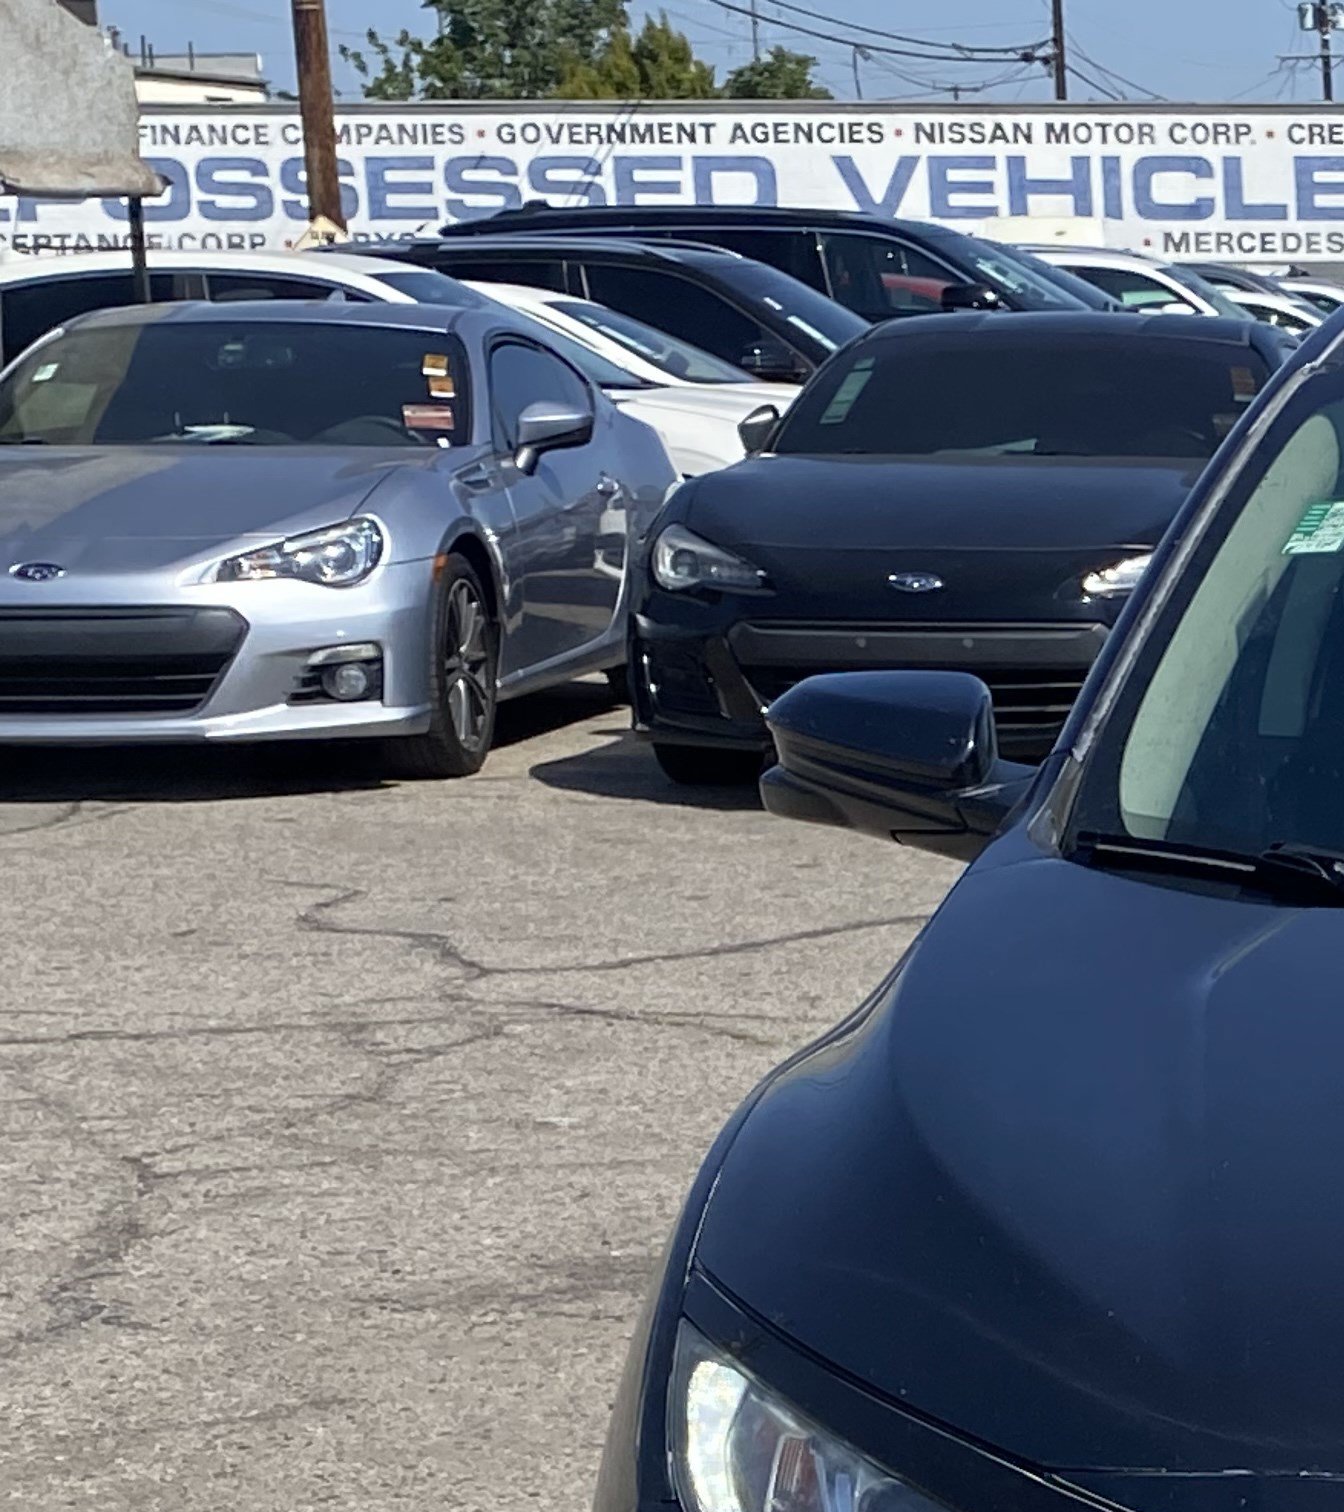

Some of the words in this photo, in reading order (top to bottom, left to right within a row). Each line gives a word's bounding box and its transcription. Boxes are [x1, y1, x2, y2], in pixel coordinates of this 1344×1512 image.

[281, 123, 465, 146] CMPANIES
[496, 122, 717, 145] GOVERNMENT
[729, 122, 885, 145] AGENCIES
[913, 122, 1034, 145] NISSAN
[1045, 122, 1156, 145] MOTOR
[1168, 122, 1257, 145] CORP.
